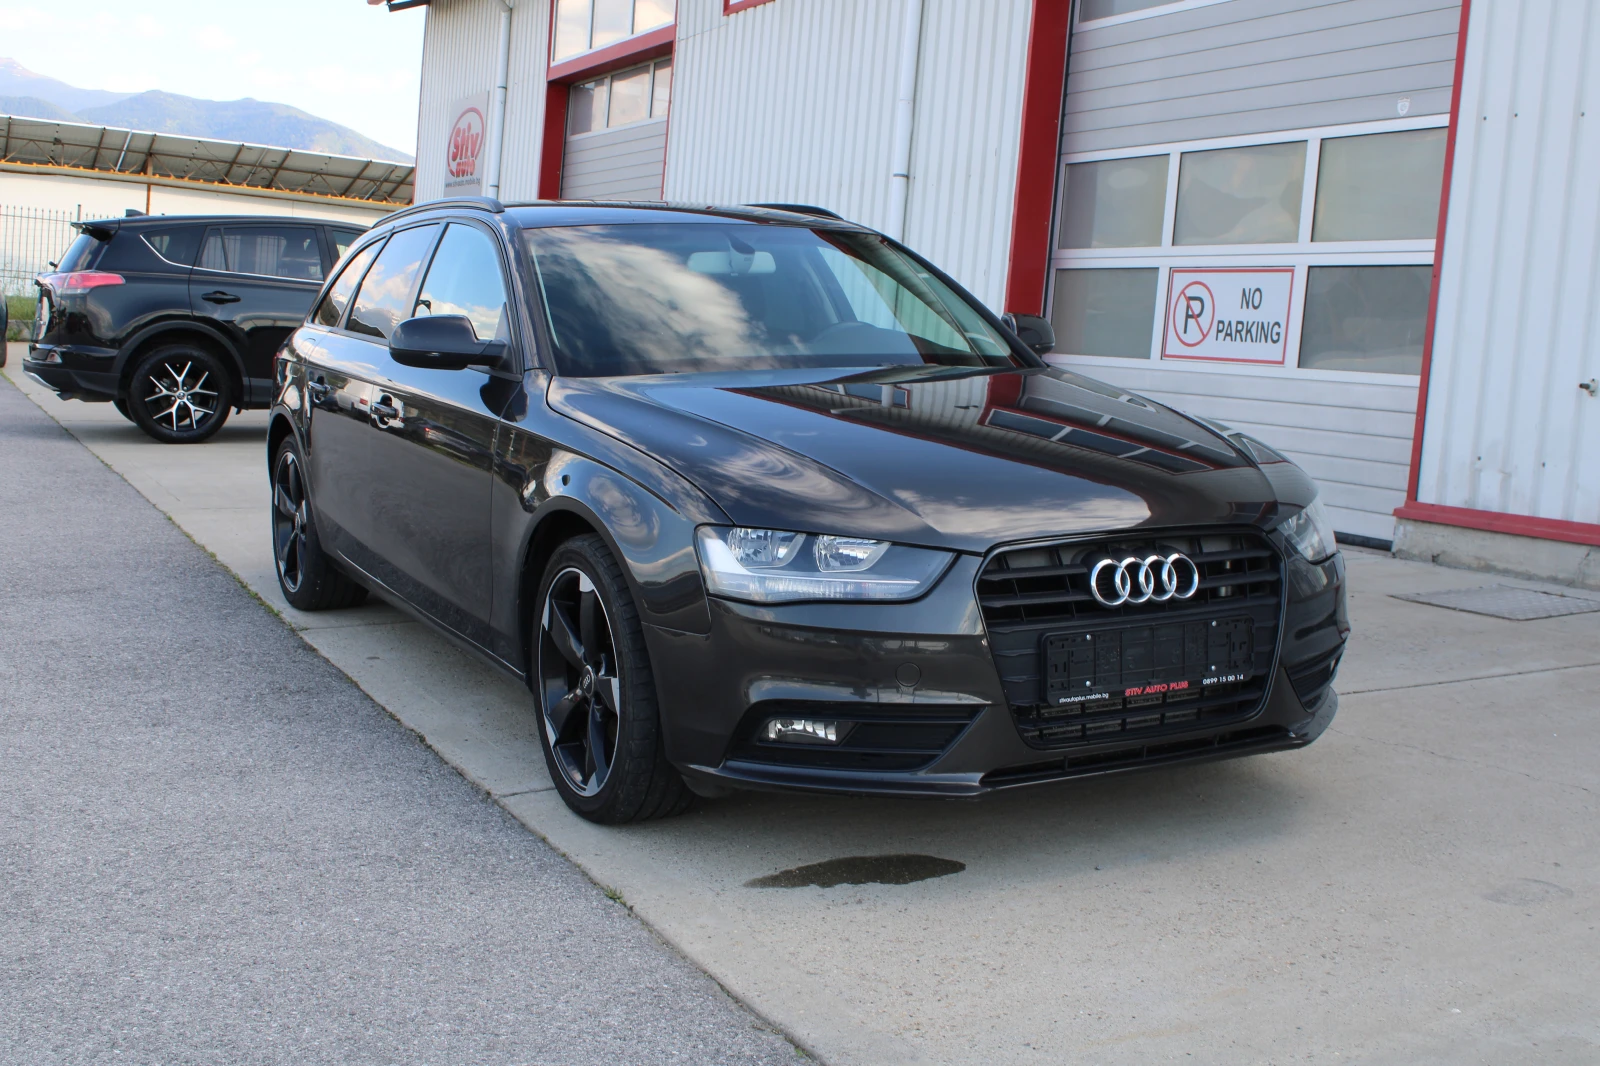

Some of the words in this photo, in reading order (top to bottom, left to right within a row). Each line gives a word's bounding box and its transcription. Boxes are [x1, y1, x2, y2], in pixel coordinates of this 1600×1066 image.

[1240, 287, 1263, 310] NO
[1215, 320, 1281, 344] PARKING
[1125, 687, 1143, 697] STIV
[1144, 683, 1168, 694] AUTO
[1169, 680, 1189, 690] PLUS
[1219, 675, 1227, 683] 15
[1227, 674, 1236, 682] 00
[1236, 673, 1244, 681] 14
